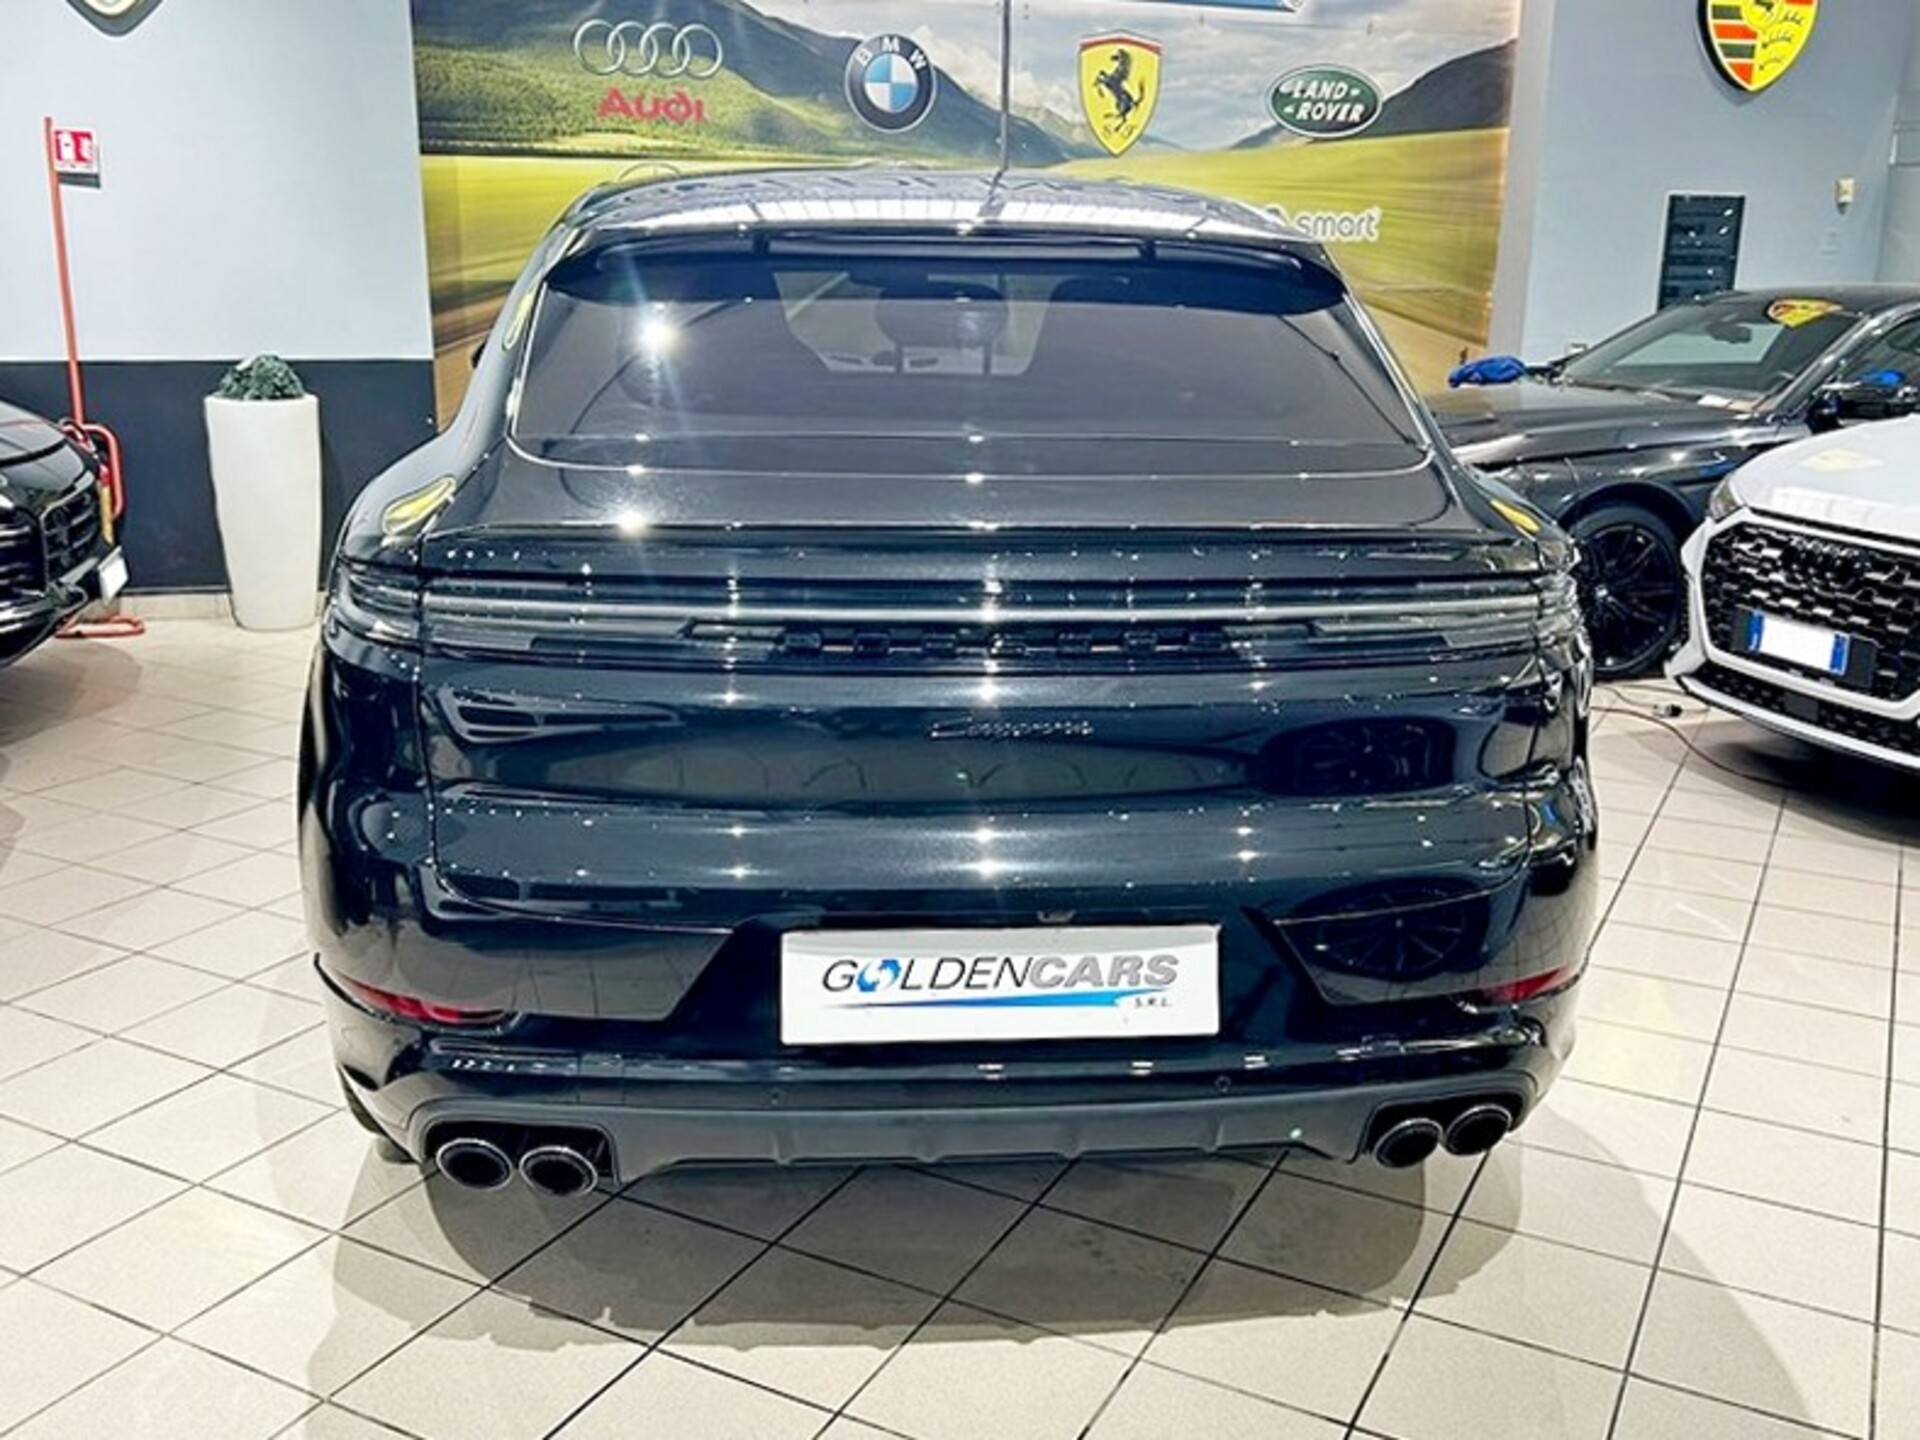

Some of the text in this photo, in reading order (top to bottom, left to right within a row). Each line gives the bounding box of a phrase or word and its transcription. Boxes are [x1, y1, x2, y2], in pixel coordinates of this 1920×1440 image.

[855, 36, 927, 69] BMW
[597, 86, 705, 121] Audi
[1293, 80, 1348, 100] LAND
[1296, 101, 1364, 122] ROVER
[1296, 209, 1379, 240] smart
